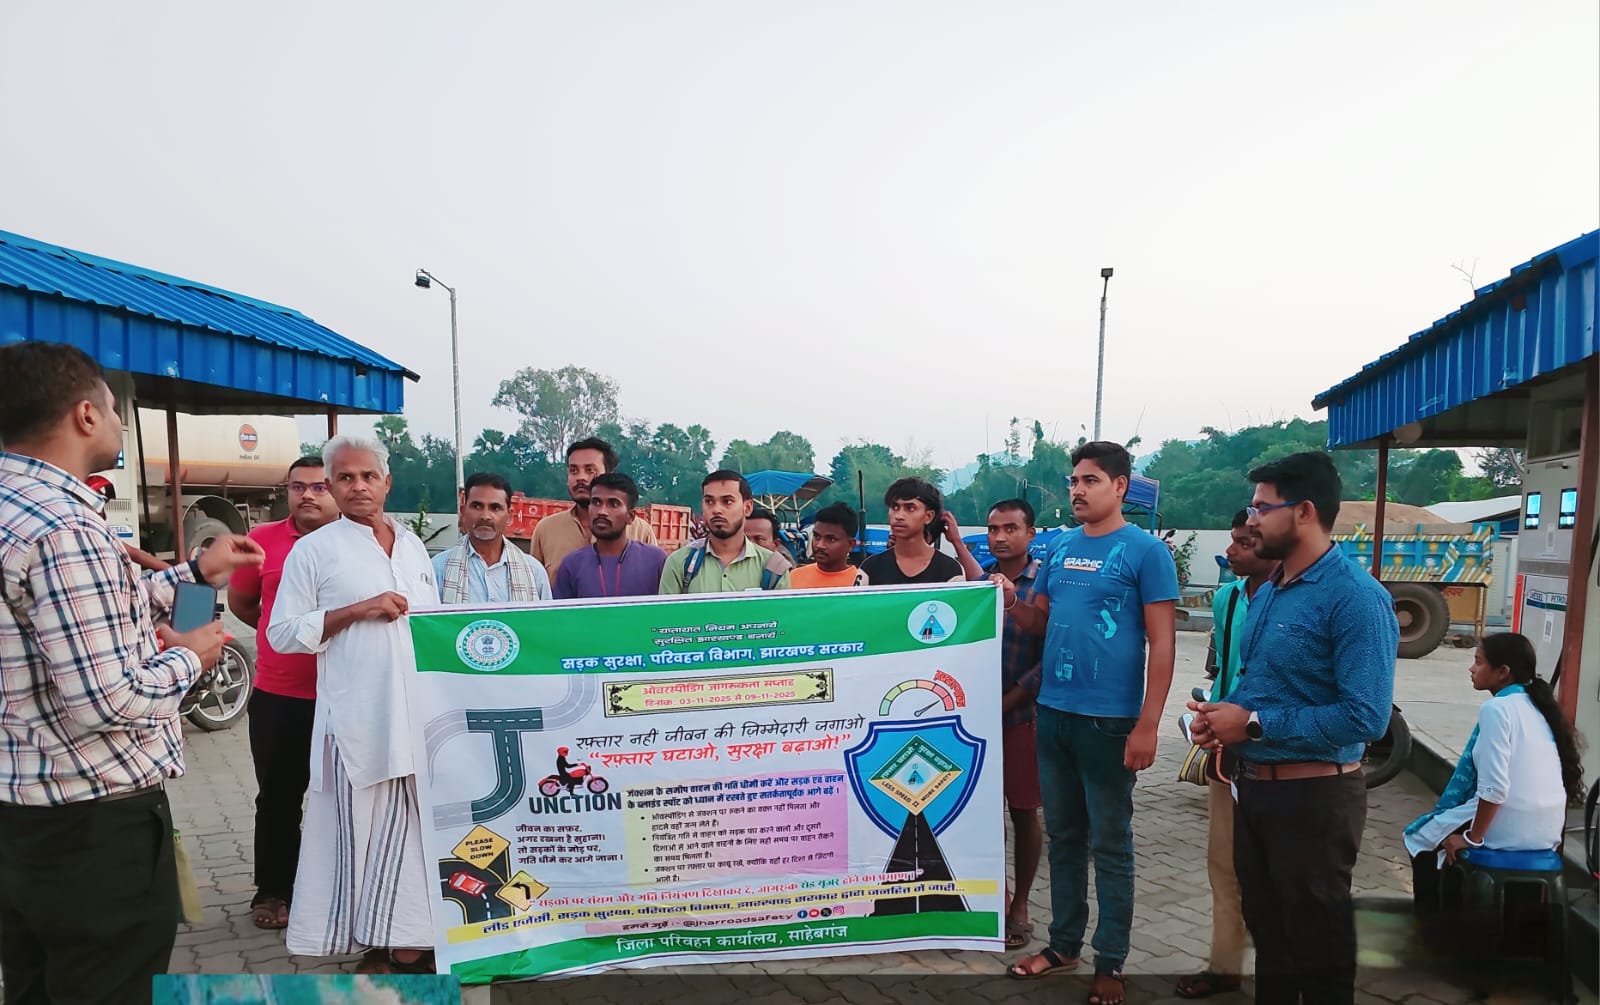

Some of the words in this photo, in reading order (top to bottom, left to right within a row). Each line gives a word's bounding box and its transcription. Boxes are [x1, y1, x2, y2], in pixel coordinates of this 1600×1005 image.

[1063, 557, 1103, 568] GRAPHIC
[705, 623, 735, 632] नियम
[654, 636, 692, 646] सुरक्षित
[697, 633, 743, 643] झारखण्ड
[561, 657, 599, 672] सड़क
[603, 655, 646, 671] सुरक्षा,
[650, 649, 704, 665] परिवहन
[709, 647, 756, 661] विभाग,
[760, 645, 815, 659] झारखण्ड
[819, 642, 864, 655] सरकार
[763, 678, 795, 689] सप्ताह
[679, 695, 731, 705] 03-11-2025
[735, 693, 742, 701] से
[745, 691, 796, 700] 09-11-2025
[665, 725, 709, 742] जीवन
[714, 722, 736, 739] की
[815, 713, 866, 732] जगाओ
[661, 742, 719, 762] घटाओ,
[727, 742, 777, 761] सुरक्षा
[656, 787, 663, 796] के
[665, 785, 688, 795] समीप
[691, 784, 711, 793] वाहन
[712, 782, 723, 791] की
[724, 781, 738, 790] गति
[740, 779, 758, 789] धीमी
[775, 777, 789, 787] और
[791, 777, 811, 786] सड़क
[824, 774, 844, 783] वाहन
[881, 780, 895, 792] LESS
[895, 789, 912, 803] SPEED
[921, 786, 935, 801] MORE
[935, 773, 952, 788] SAFETY
[627, 800, 635, 809] के
[637, 799, 661, 808] ब्लाइंड
[663, 797, 681, 807] स्पॉट
[682, 796, 693, 805] को
[694, 795, 714, 804] ध्यान
[725, 792, 745, 801] रखते
[747, 791, 758, 801] हुए
[759, 788, 804, 799] सतर्कतापूर्वक
[806, 786, 821, 796] आगे
[688, 810, 695, 818] से
[718, 807, 727, 815] पर
[747, 806, 756, 814] का
[787, 803, 807, 811] मिलता
[809, 801, 820, 809] और
[516, 824, 541, 832] जीवन
[651, 823, 669, 832] हादसे
[684, 820, 697, 829] जन्म
[678, 831, 690, 840] गति
[692, 830, 698, 839] से
[700, 829, 715, 838] वाहन
[759, 825, 774, 833] करने
[793, 823, 804, 831] और
[465, 837, 494, 846] PLEASE
[517, 835, 538, 843] अगर
[539, 835, 564, 843] रखना
[566, 834, 572, 843] है
[678, 842, 684, 850] से
[686, 841, 699, 850] आने
[700, 840, 714, 848] वाले
[744, 837, 758, 845] लिए
[759, 836, 771, 844] सही
[773, 835, 789, 843] समय
[800, 833, 816, 841] वाहन
[470, 852, 494, 860] DOWN
[517, 845, 528, 854] तो
[529, 844, 555, 855] सड़कों
[557, 844, 566, 853] के
[568, 844, 585, 854] मोड़
[682, 851, 702, 860] मिलता
[518, 855, 537, 864] गति
[538, 855, 556, 863] धीमे
[574, 854, 594, 863] आगे
[595, 854, 618, 862] जाना
[782, 855, 790, 863] हर
[791, 854, 806, 862] दिशा
[655, 874, 671, 883] आती
[571, 897, 584, 905] पर
[616, 893, 635, 902] और
[638, 891, 658, 901] गति
[661, 890, 699, 900] नियंत्रण
[701, 886, 742, 898] दिखाकर
[800, 880, 815, 889] रोड
[842, 875, 859, 885] होने
[861, 874, 876, 883] का
[483, 921, 509, 934] लीड
[557, 912, 590, 920] सड़क
[637, 905, 687, 915] परिवहन
[795, 892, 838, 902] सरकार
[841, 889, 864, 899] द्वारा
[868, 886, 911, 896] जनहित
[622, 922, 649, 931] हमसे
[683, 914, 793, 928] @jharroadsafety
[616, 937, 654, 953] जिला
[659, 933, 711, 948] परिवहन
[787, 923, 848, 941] साहेबगंज
